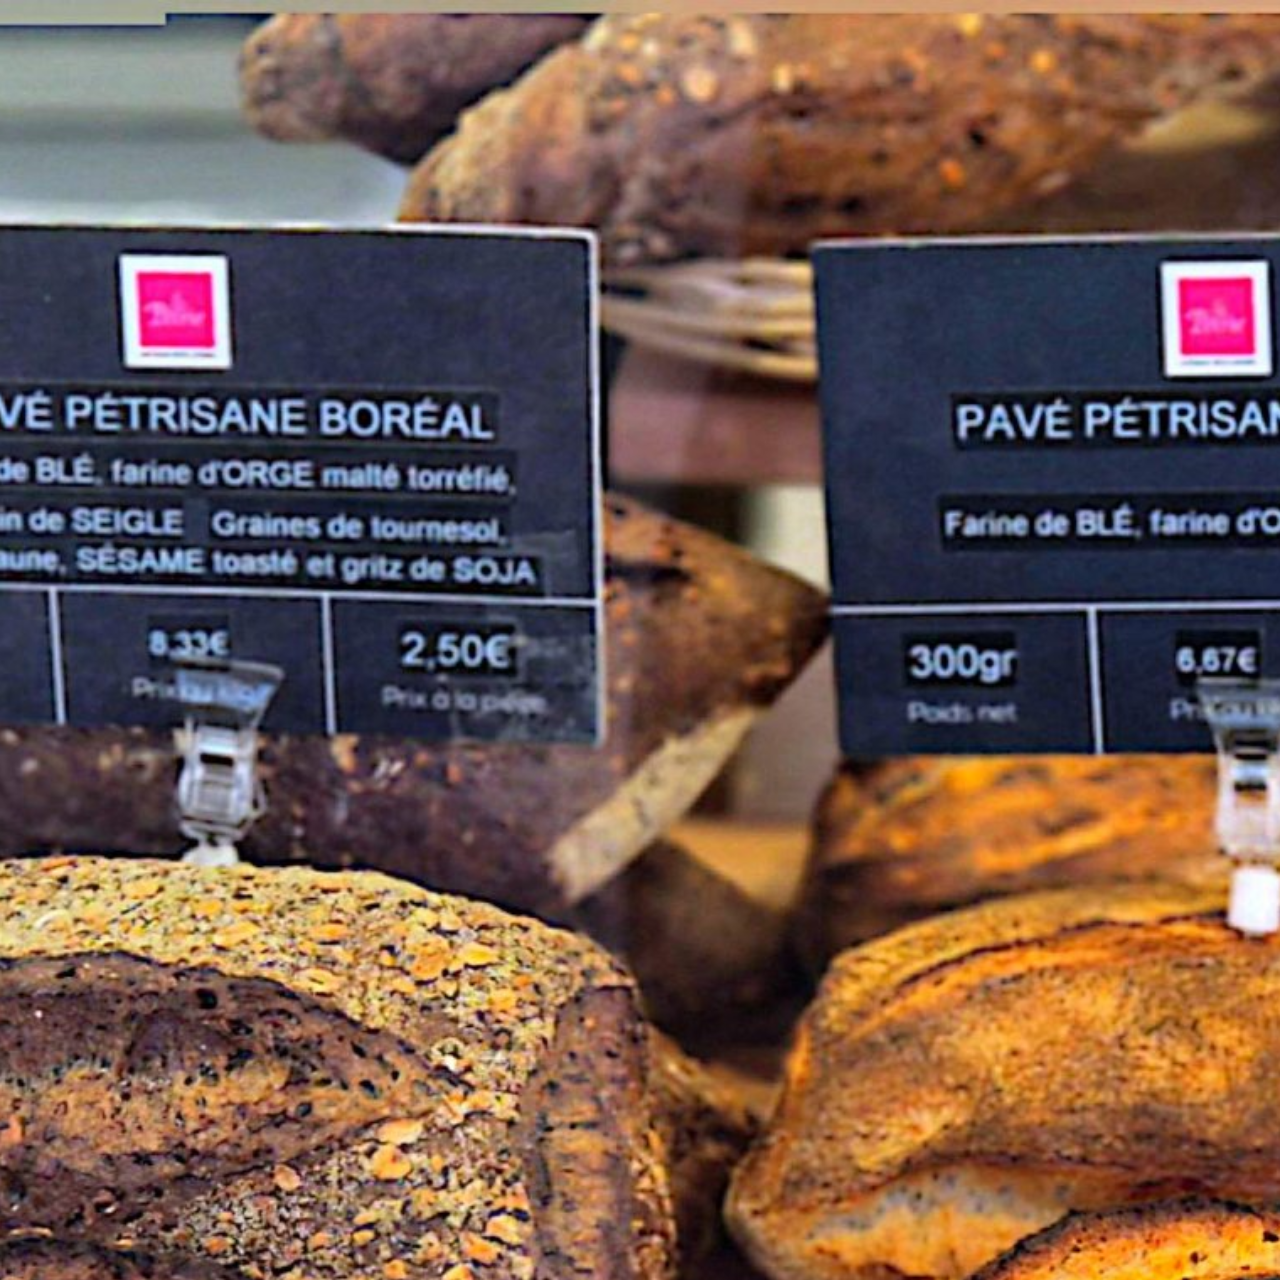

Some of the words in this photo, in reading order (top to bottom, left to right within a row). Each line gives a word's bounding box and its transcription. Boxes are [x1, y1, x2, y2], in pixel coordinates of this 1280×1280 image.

[66, 392, 307, 434] PÉTRISANE
[319, 397, 494, 440] BORÉAL
[956, 397, 1073, 440] PAVÉ
[111, 459, 192, 485] farine
[198, 459, 314, 487] d'ORGE
[322, 464, 399, 488] malté
[28, 507, 65, 533] de
[71, 507, 184, 535] SEIGLE
[212, 510, 321, 538] Graines
[327, 514, 363, 539] de
[944, 510, 1029, 537] Farine
[1034, 510, 1069, 536] de
[1075, 503, 1142, 539] BLÉ,
[1150, 510, 1230, 535] farine
[76, 542, 204, 574] SÉSAME
[212, 549, 297, 576] toasté
[306, 555, 335, 578] et
[341, 556, 403, 583] gritz
[409, 557, 446, 582] de
[453, 555, 536, 586] SOJA
[400, 631, 511, 670] 2,50€
[909, 643, 1018, 684] 300gr
[907, 701, 973, 724] Poids
